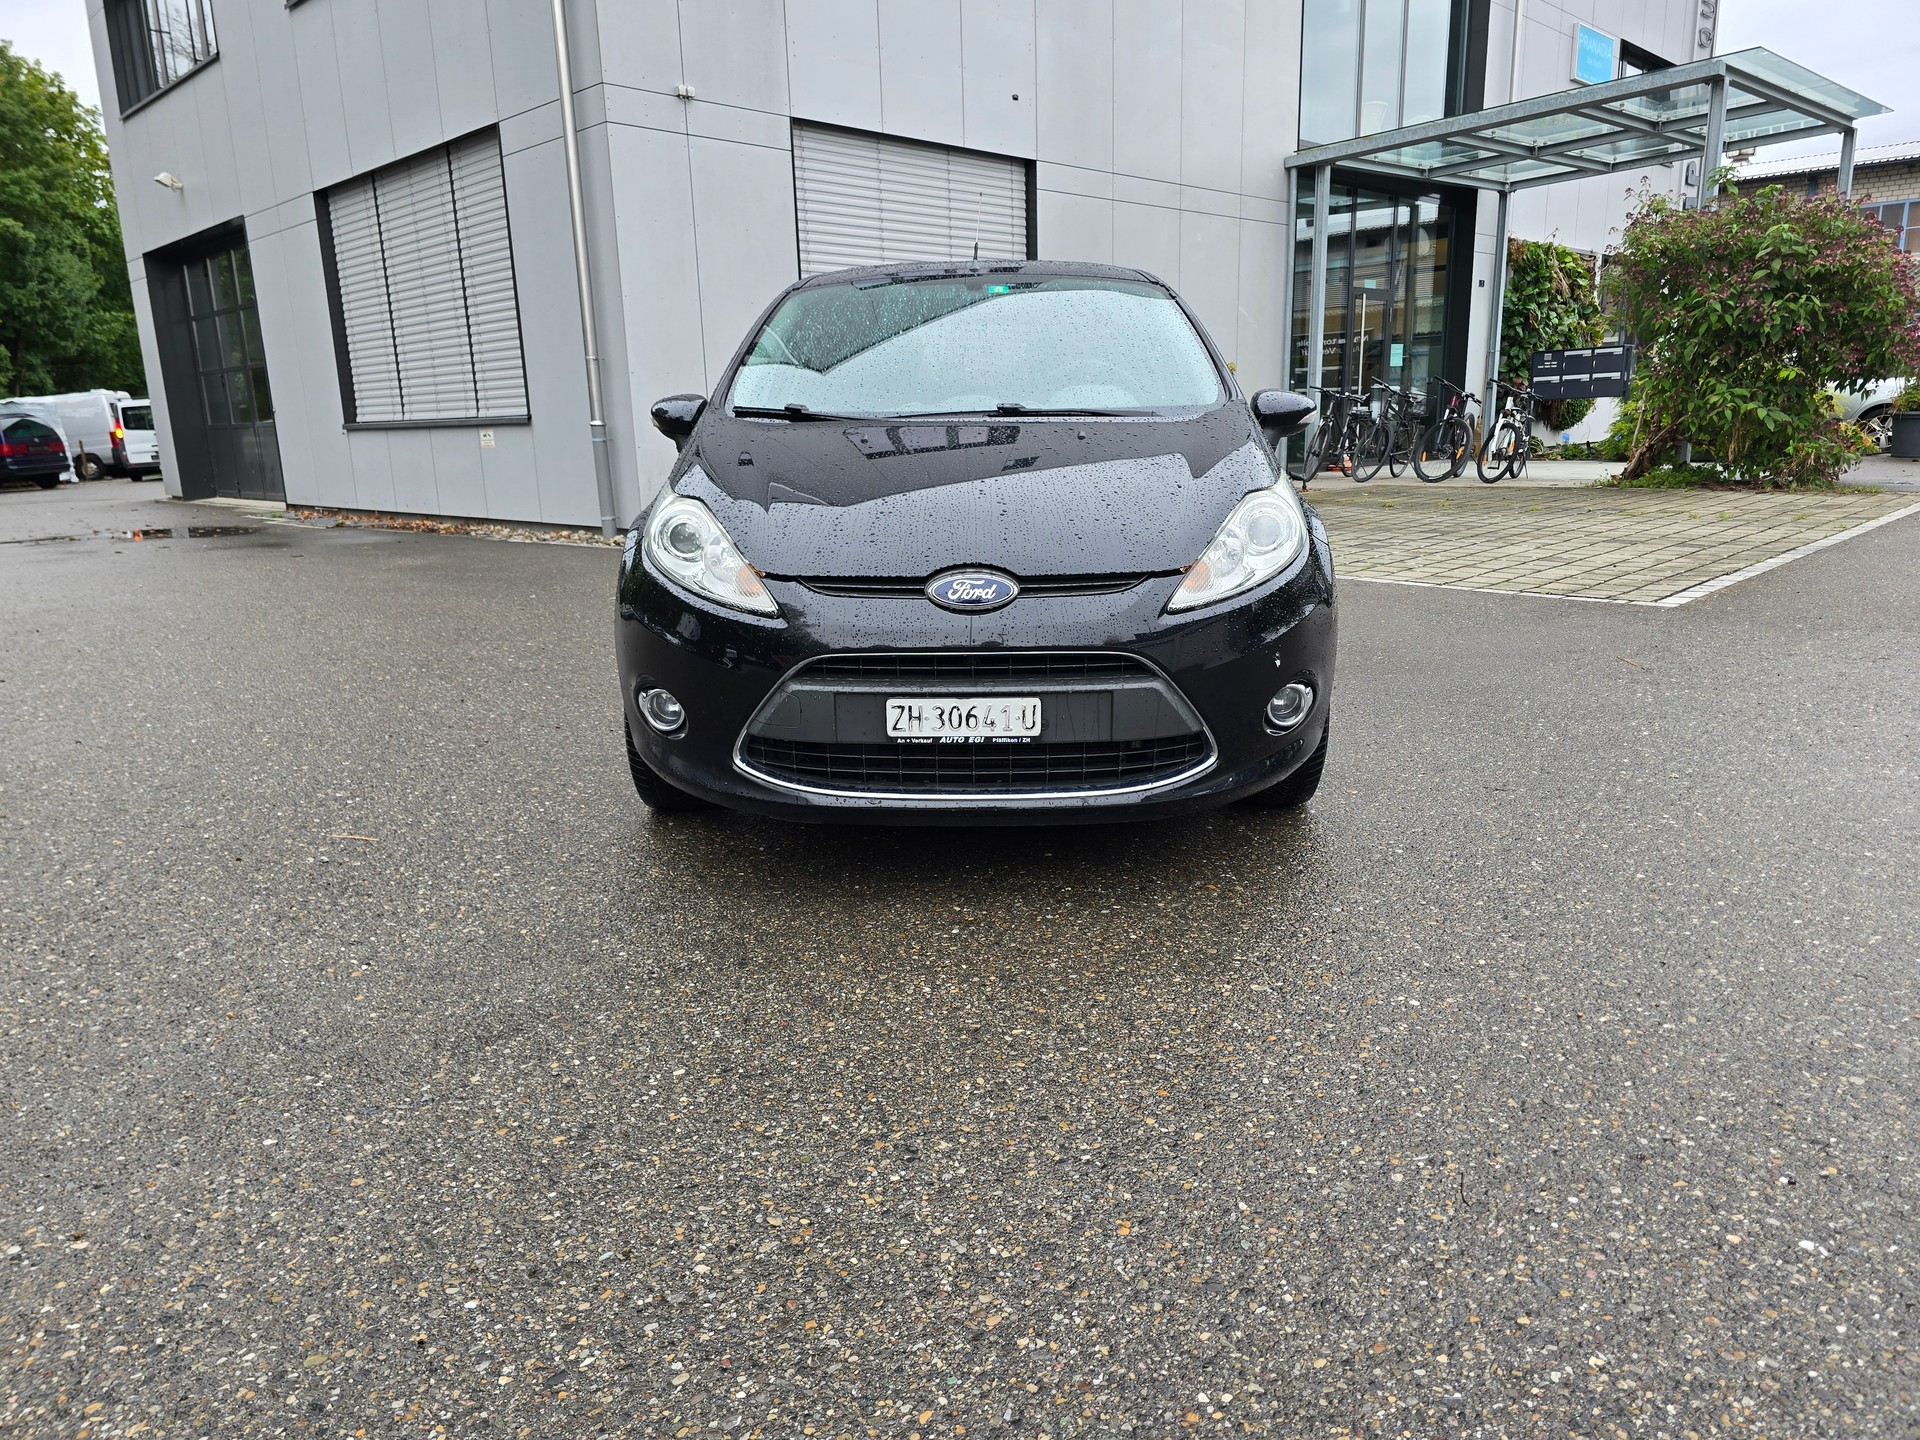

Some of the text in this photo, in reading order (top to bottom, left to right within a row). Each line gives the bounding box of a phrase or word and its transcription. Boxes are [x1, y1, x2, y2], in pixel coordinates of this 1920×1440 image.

[947, 579, 998, 600] Ford
[939, 736, 965, 744] AUTO
[968, 736, 985, 744] EGI
